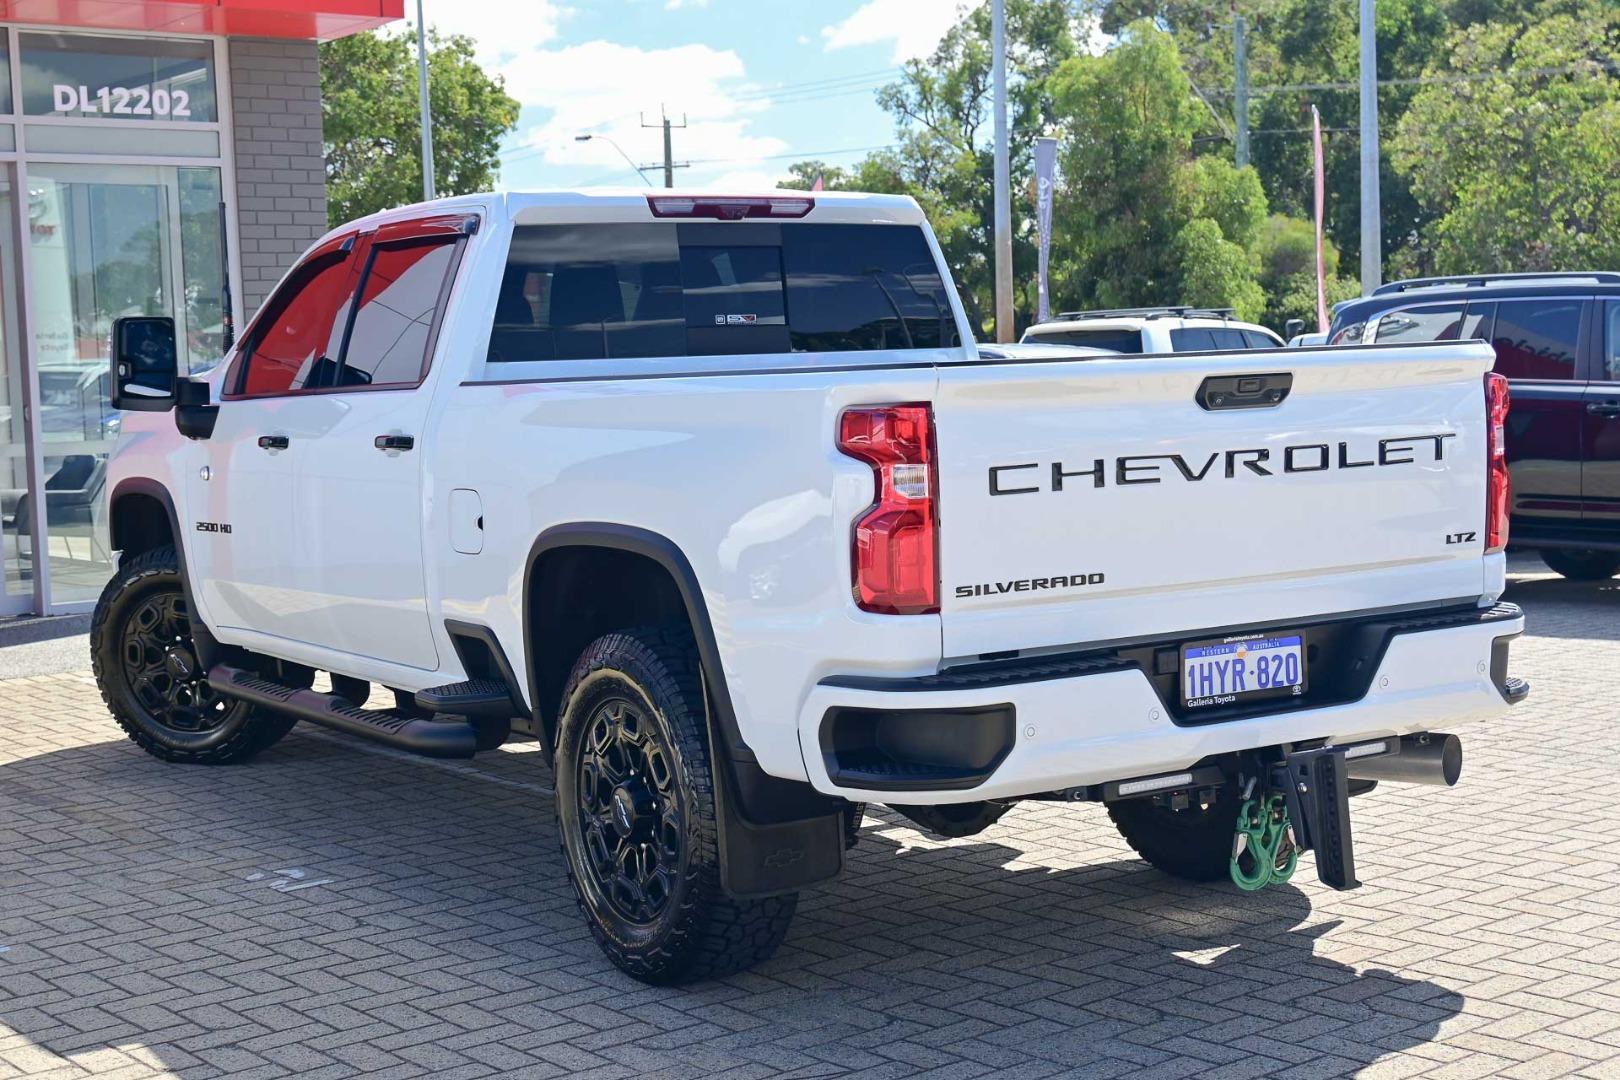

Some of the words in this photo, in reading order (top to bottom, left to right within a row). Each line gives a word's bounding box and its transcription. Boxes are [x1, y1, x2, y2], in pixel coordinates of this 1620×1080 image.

[53, 84, 192, 116] DL12202
[988, 433, 1457, 496] CHEVROLET
[196, 521, 219, 532] 2500
[220, 523, 232, 534] HD
[1446, 531, 1477, 544] LTZ
[955, 573, 1105, 598] SILVERADO
[1201, 647, 1230, 656] WESTERN
[1252, 641, 1280, 650] AUSTRALIA
[1187, 696, 1213, 708] Galleria
[1214, 694, 1236, 705] Toyota
